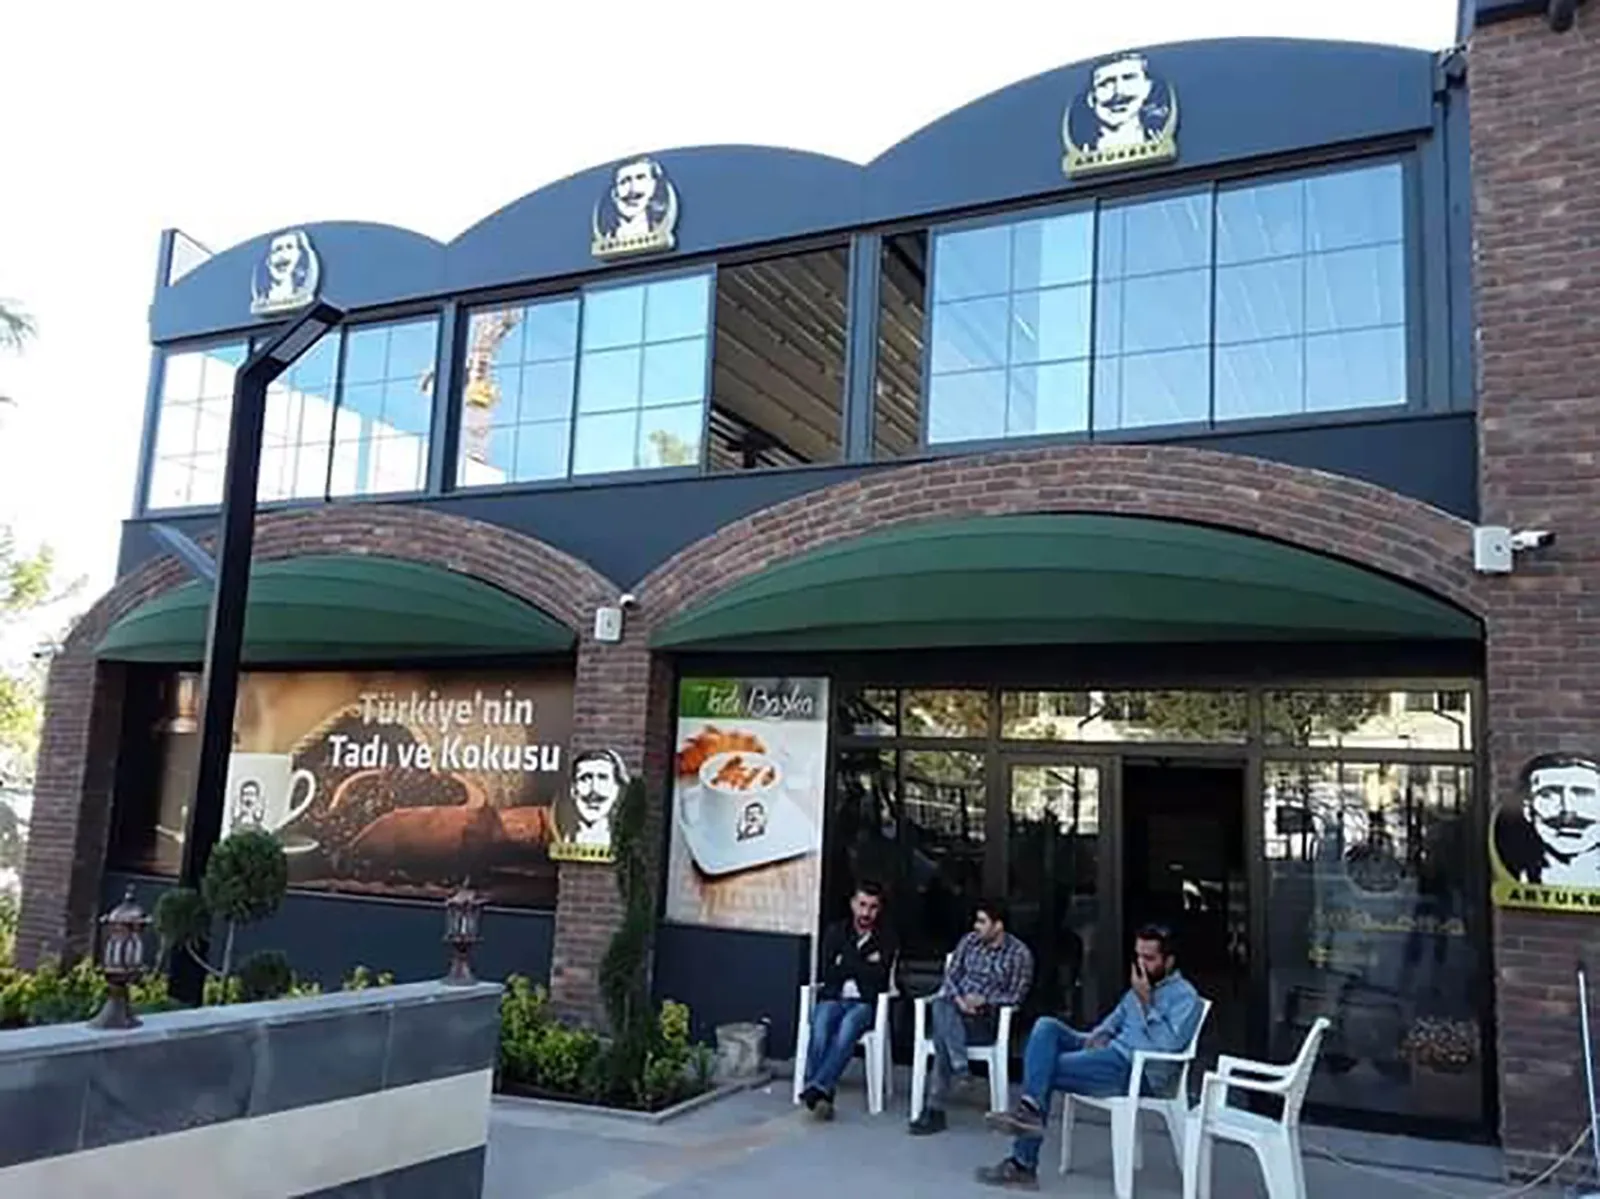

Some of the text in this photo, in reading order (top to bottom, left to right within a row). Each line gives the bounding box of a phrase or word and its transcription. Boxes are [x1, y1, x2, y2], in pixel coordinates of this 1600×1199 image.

[358, 690, 534, 732] Türkiye'nin
[328, 734, 561, 772] Tadı ve Kokusu
